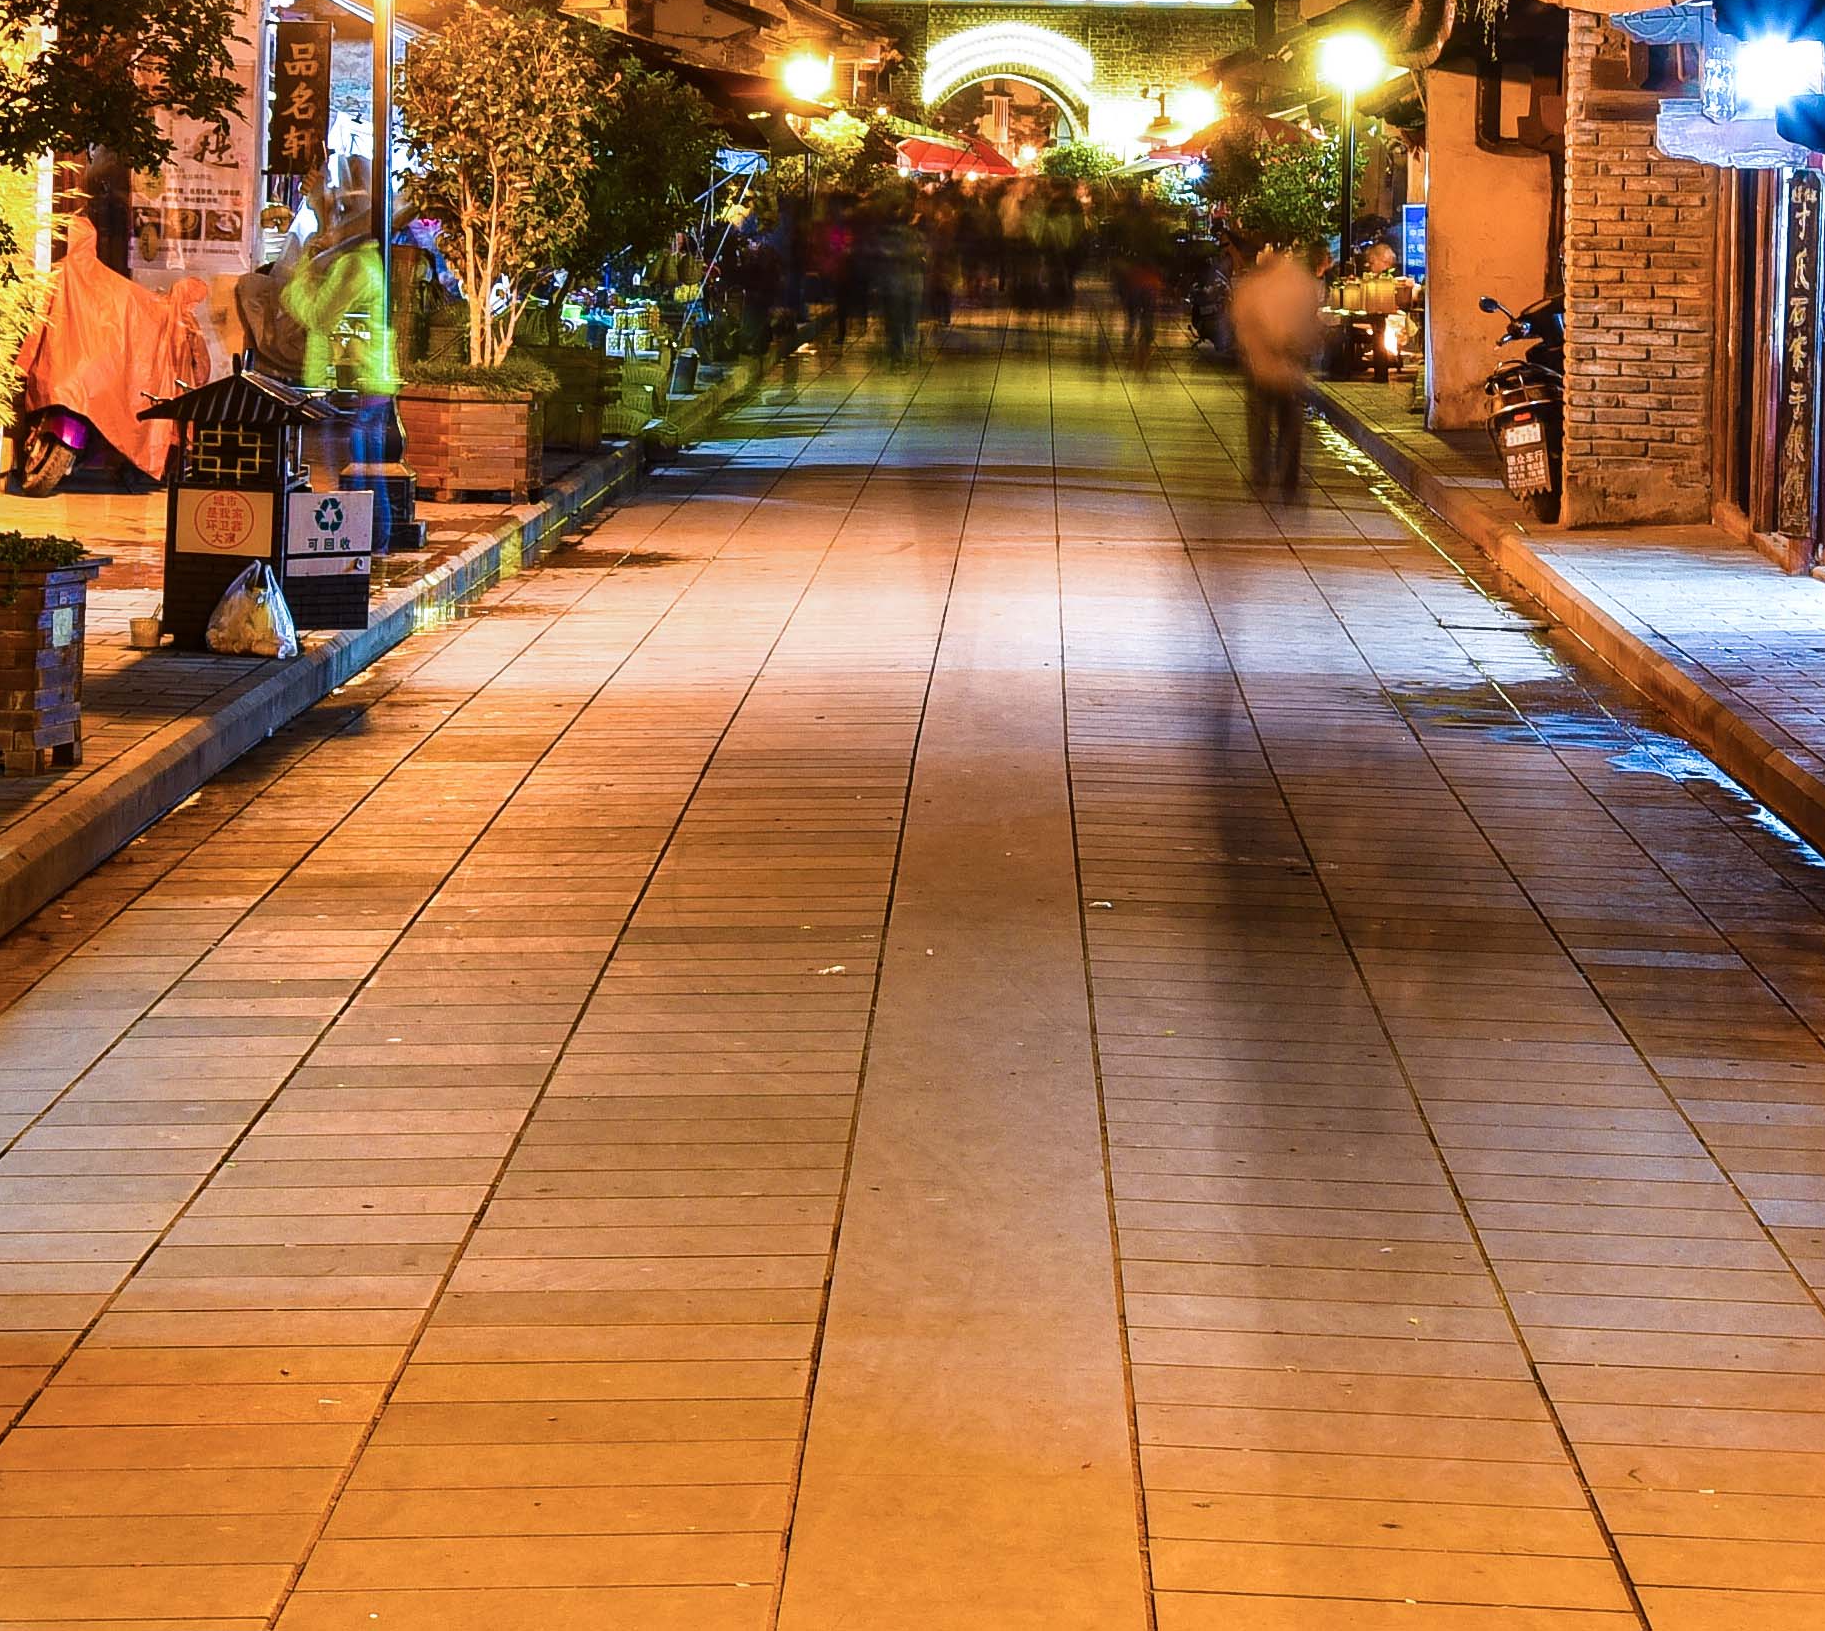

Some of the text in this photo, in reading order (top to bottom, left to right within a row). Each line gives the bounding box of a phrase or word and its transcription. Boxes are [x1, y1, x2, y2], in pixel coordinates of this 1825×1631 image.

[281, 42, 319, 162] 品名轩
[307, 537, 352, 552] 可回收
